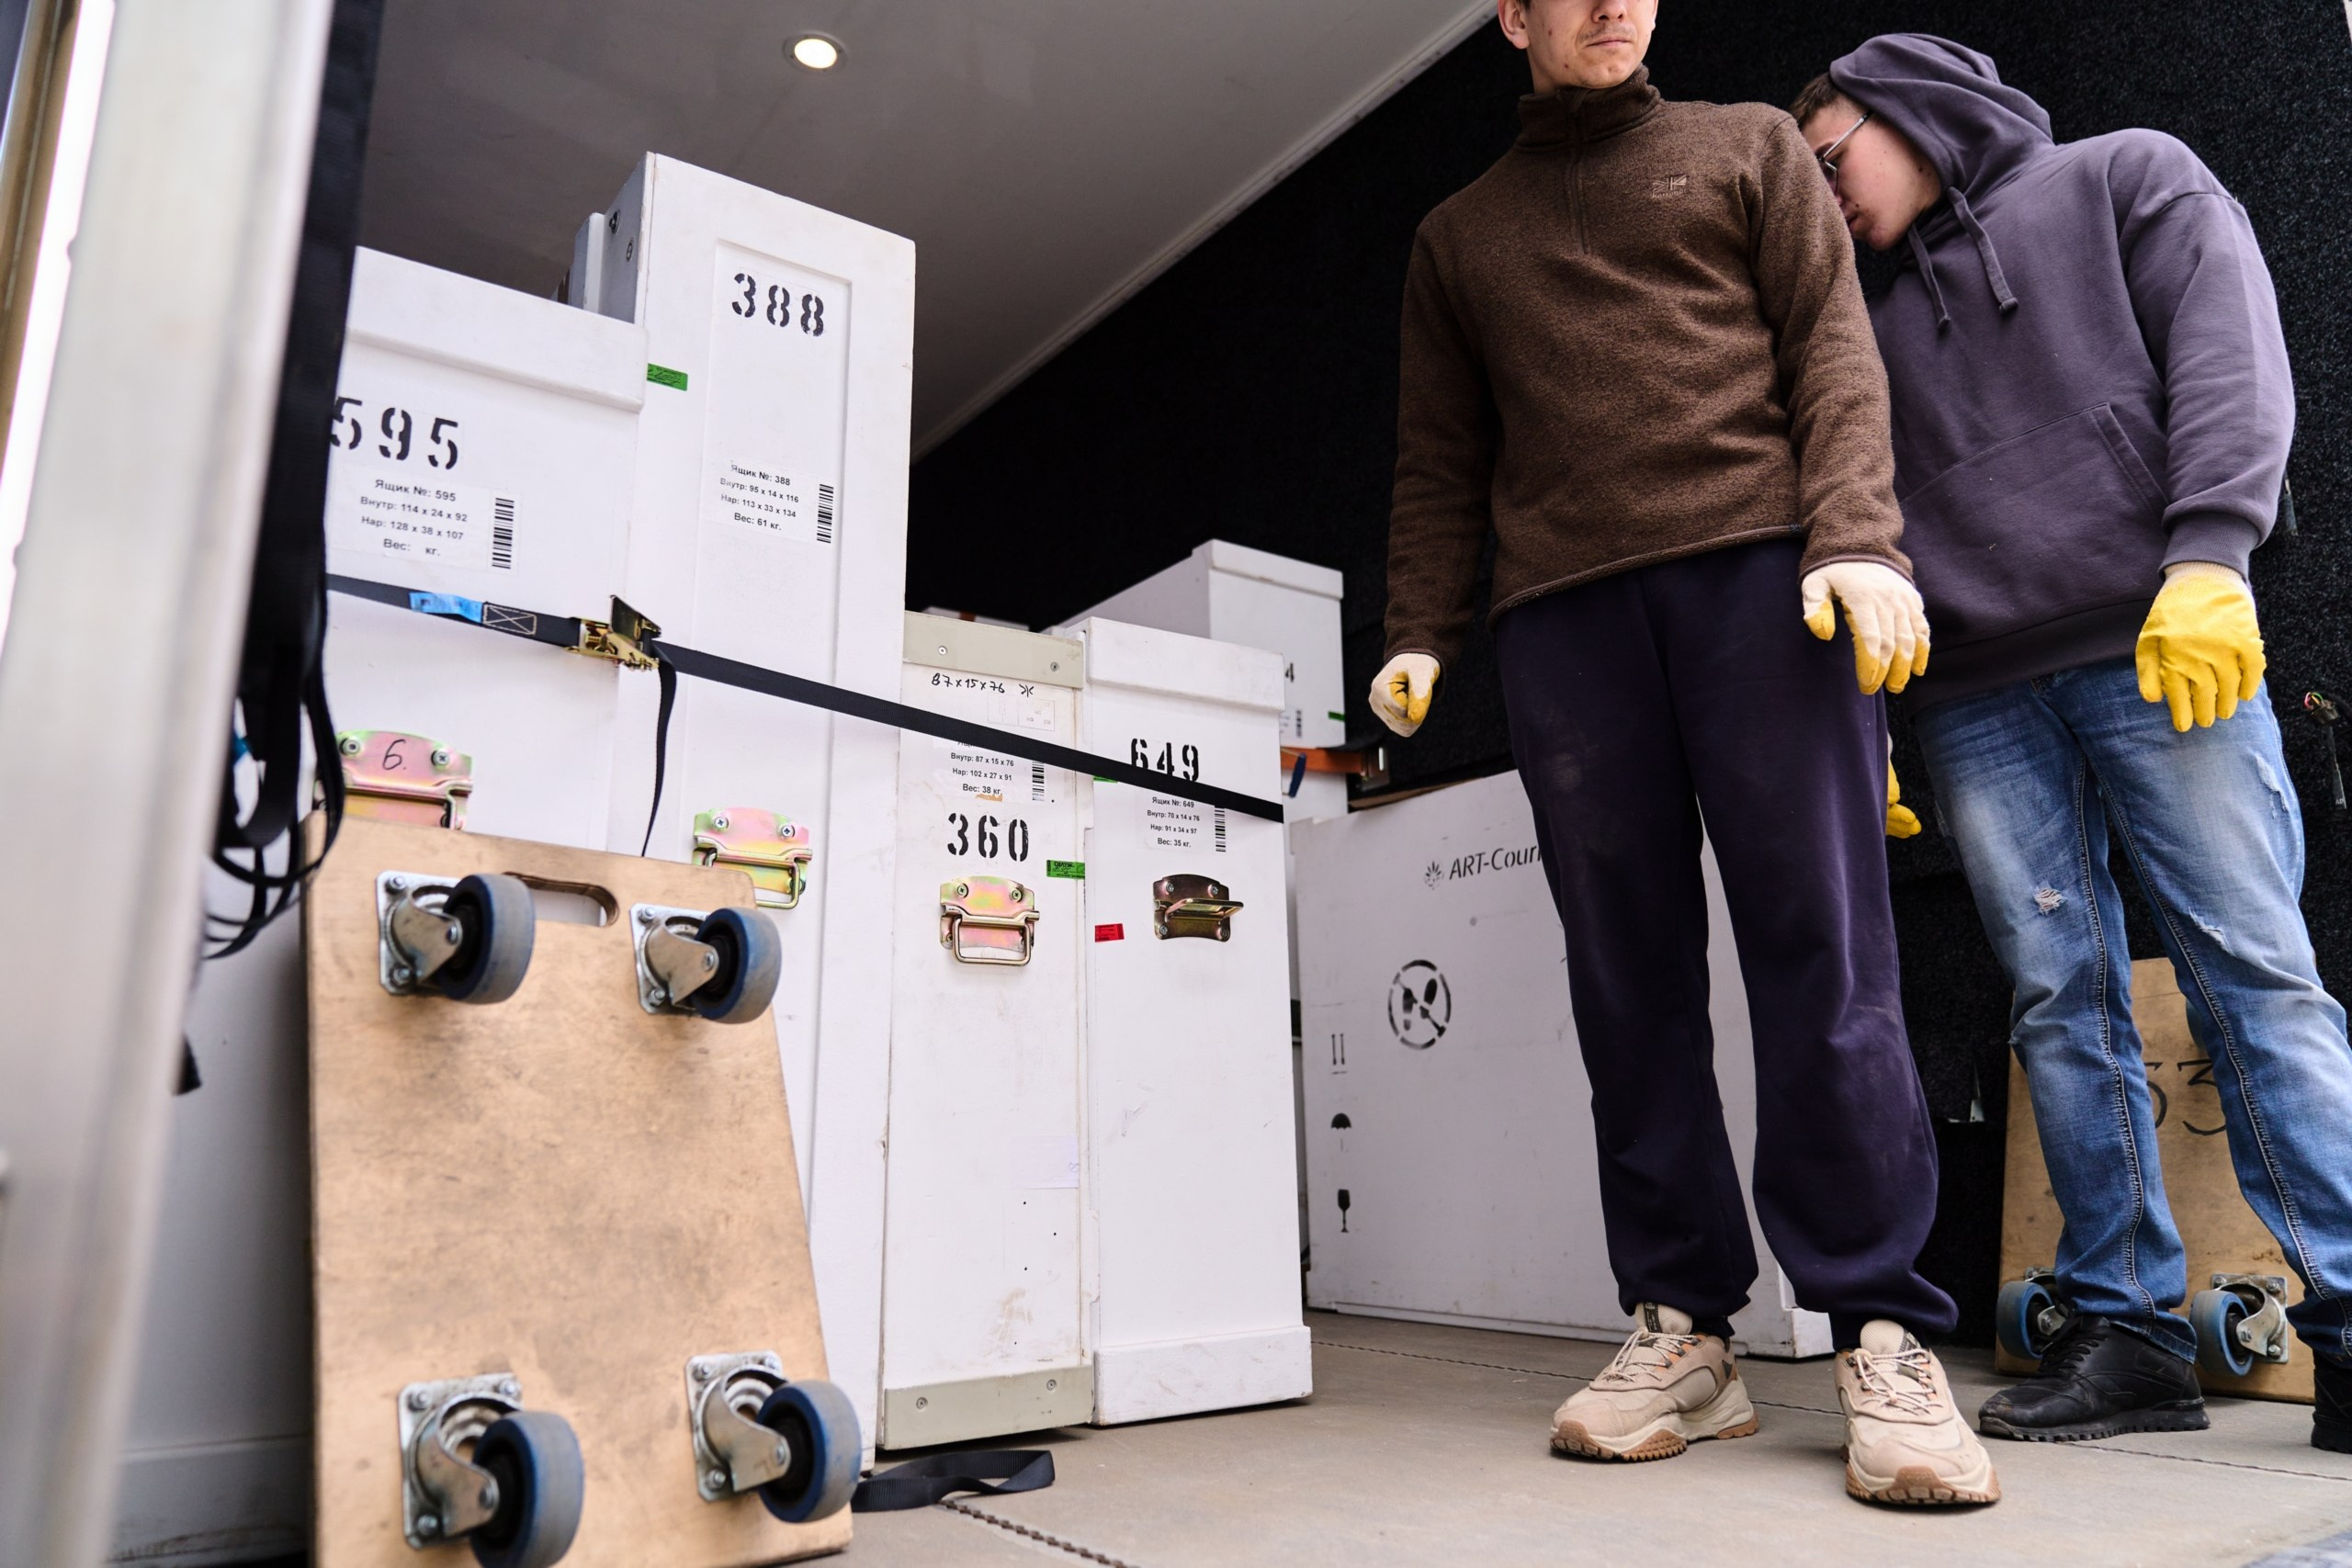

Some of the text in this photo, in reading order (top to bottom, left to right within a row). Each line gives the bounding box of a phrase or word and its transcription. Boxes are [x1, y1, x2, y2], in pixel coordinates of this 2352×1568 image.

[732, 273, 825, 337] 388
[332, 396, 459, 470] 595
[730, 464, 756, 478] Ящик
[775, 476, 791, 486] 388
[375, 479, 410, 494] Ящик
[435, 490, 457, 502] 595
[720, 478, 748, 491] Внутр:
[750, 485, 759, 493] 95
[768, 490, 777, 498] 14
[786, 494, 799, 503] 116
[360, 496, 397, 512] Внутр:
[401, 502, 419, 513] 114
[431, 509, 444, 519] 24
[455, 513, 468, 523] 92
[720, 494, 740, 504] Нар:
[742, 499, 755, 508] 113
[764, 504, 774, 513] 33
[783, 509, 797, 518] 134
[361, 516, 387, 529] Нар:
[390, 521, 409, 532] 128
[421, 525, 434, 536] 38
[446, 530, 464, 540] 107
[734, 513, 781, 531] Вес: 61 кг.
[383, 538, 441, 557] Вес: кг.
[951, 752, 974, 763] Внутр:
[976, 755, 984, 763] 87
[1131, 739, 1200, 782] 649
[953, 768, 968, 777] Нар:
[970, 770, 982, 778] 102
[963, 784, 1002, 795] Вес: 38 кг.
[1152, 796, 1170, 807] Ящик
[1182, 800, 1194, 808] 649
[1147, 810, 1167, 819] Внутр:
[947, 813, 1029, 862] 360
[1150, 824, 1164, 832] Нар:
[1158, 838, 1172, 846] Вес:
